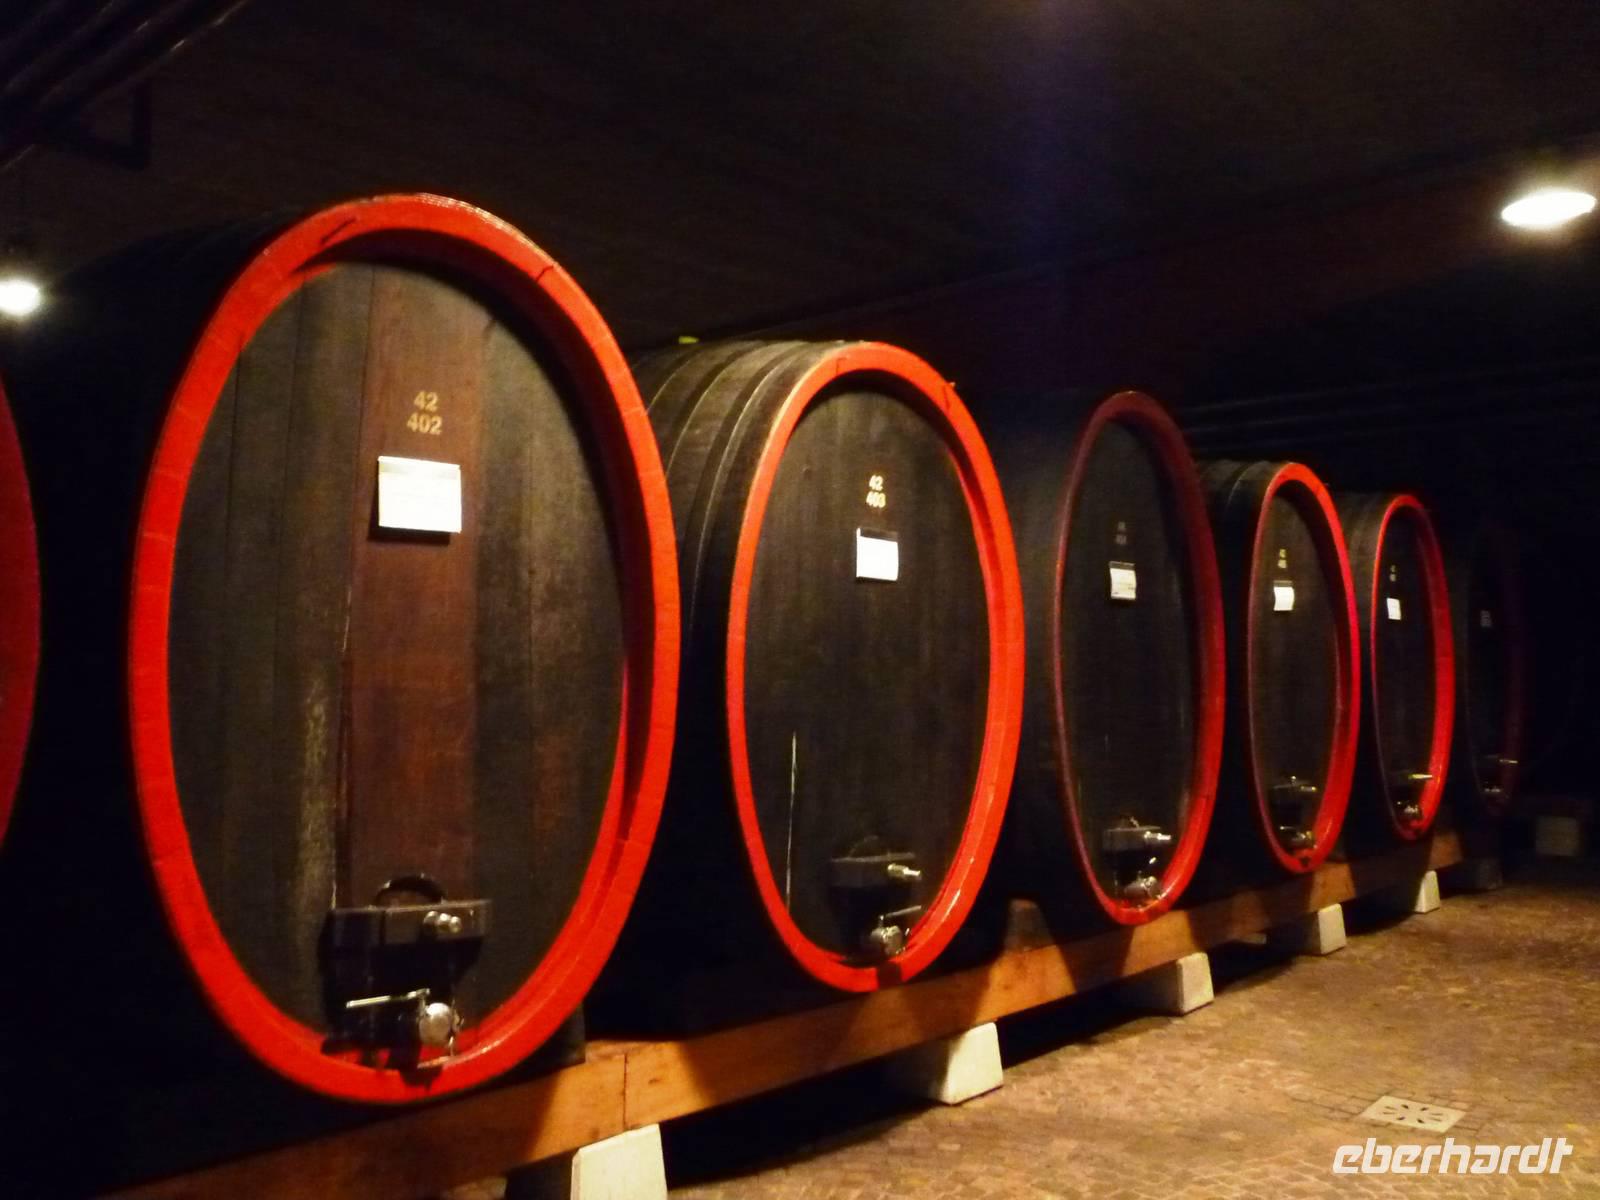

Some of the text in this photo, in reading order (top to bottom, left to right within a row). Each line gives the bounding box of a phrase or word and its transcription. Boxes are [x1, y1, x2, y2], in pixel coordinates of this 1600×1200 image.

[414, 390, 439, 412] 42
[407, 412, 442, 435] 402
[869, 474, 884, 491] 42
